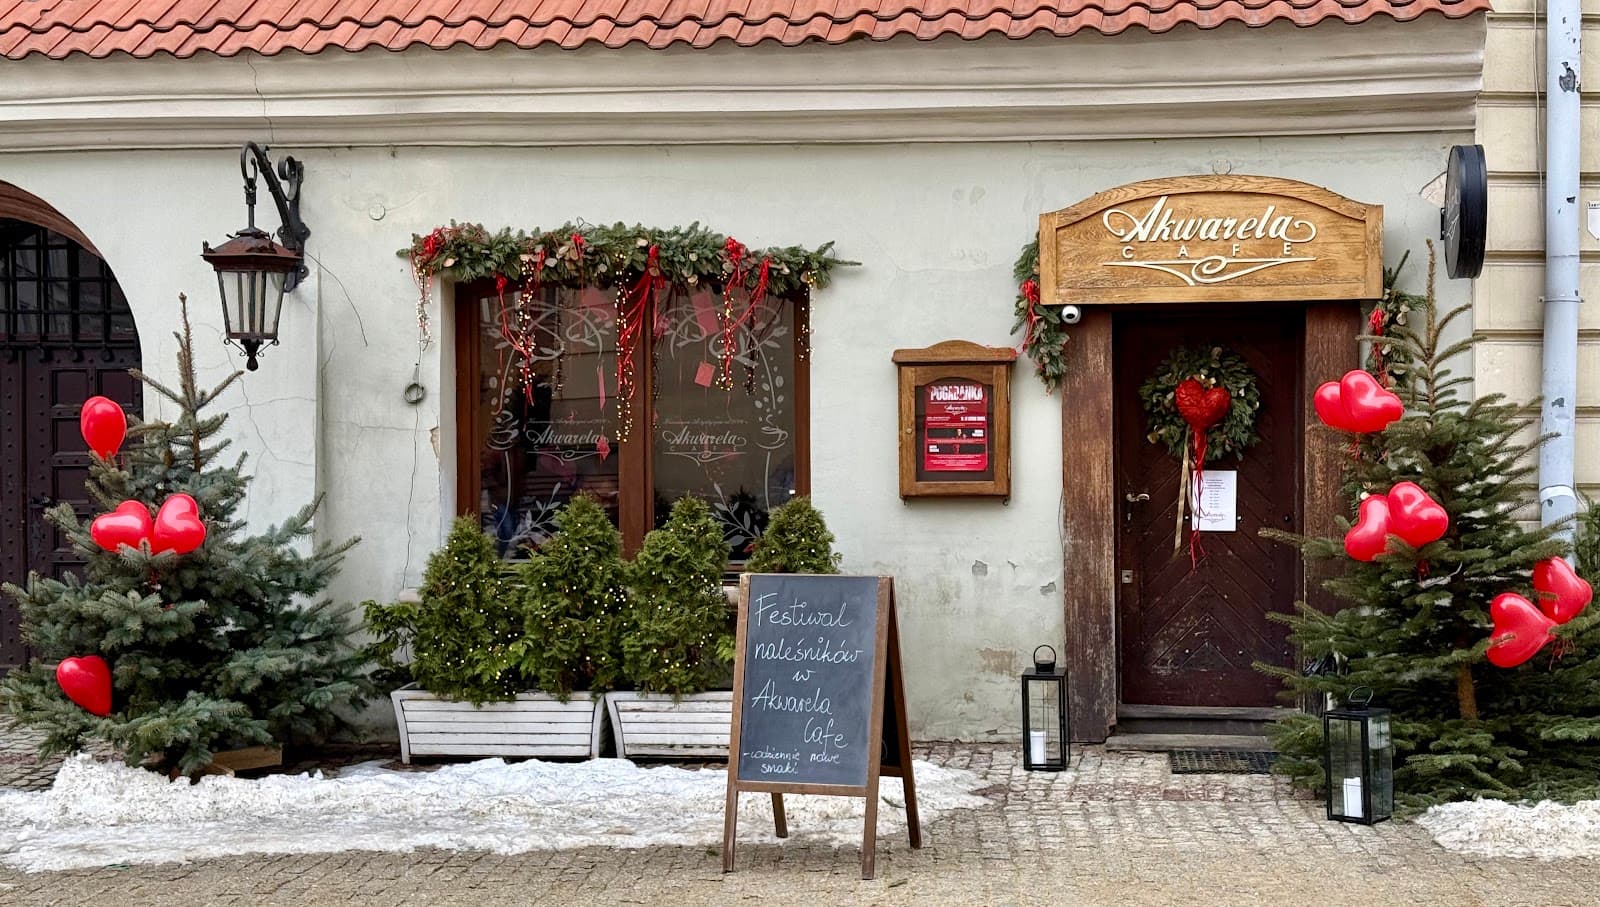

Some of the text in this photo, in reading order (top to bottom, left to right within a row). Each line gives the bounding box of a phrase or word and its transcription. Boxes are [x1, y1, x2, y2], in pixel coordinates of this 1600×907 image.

[1102, 195, 1318, 243] Akwarela
[1122, 242, 1295, 259] CAFE
[930, 385, 984, 401] POGADANKA
[526, 424, 610, 445] Akwarela
[662, 425, 747, 447] Akwarela
[755, 592, 852, 627] Festiwal
[754, 637, 864, 664] naleśników
[792, 669, 816, 682] w
[751, 678, 833, 715] Akwarela
[803, 716, 848, 755] Cafe
[809, 751, 841, 764] nowe
[760, 762, 799, 775] smaki
